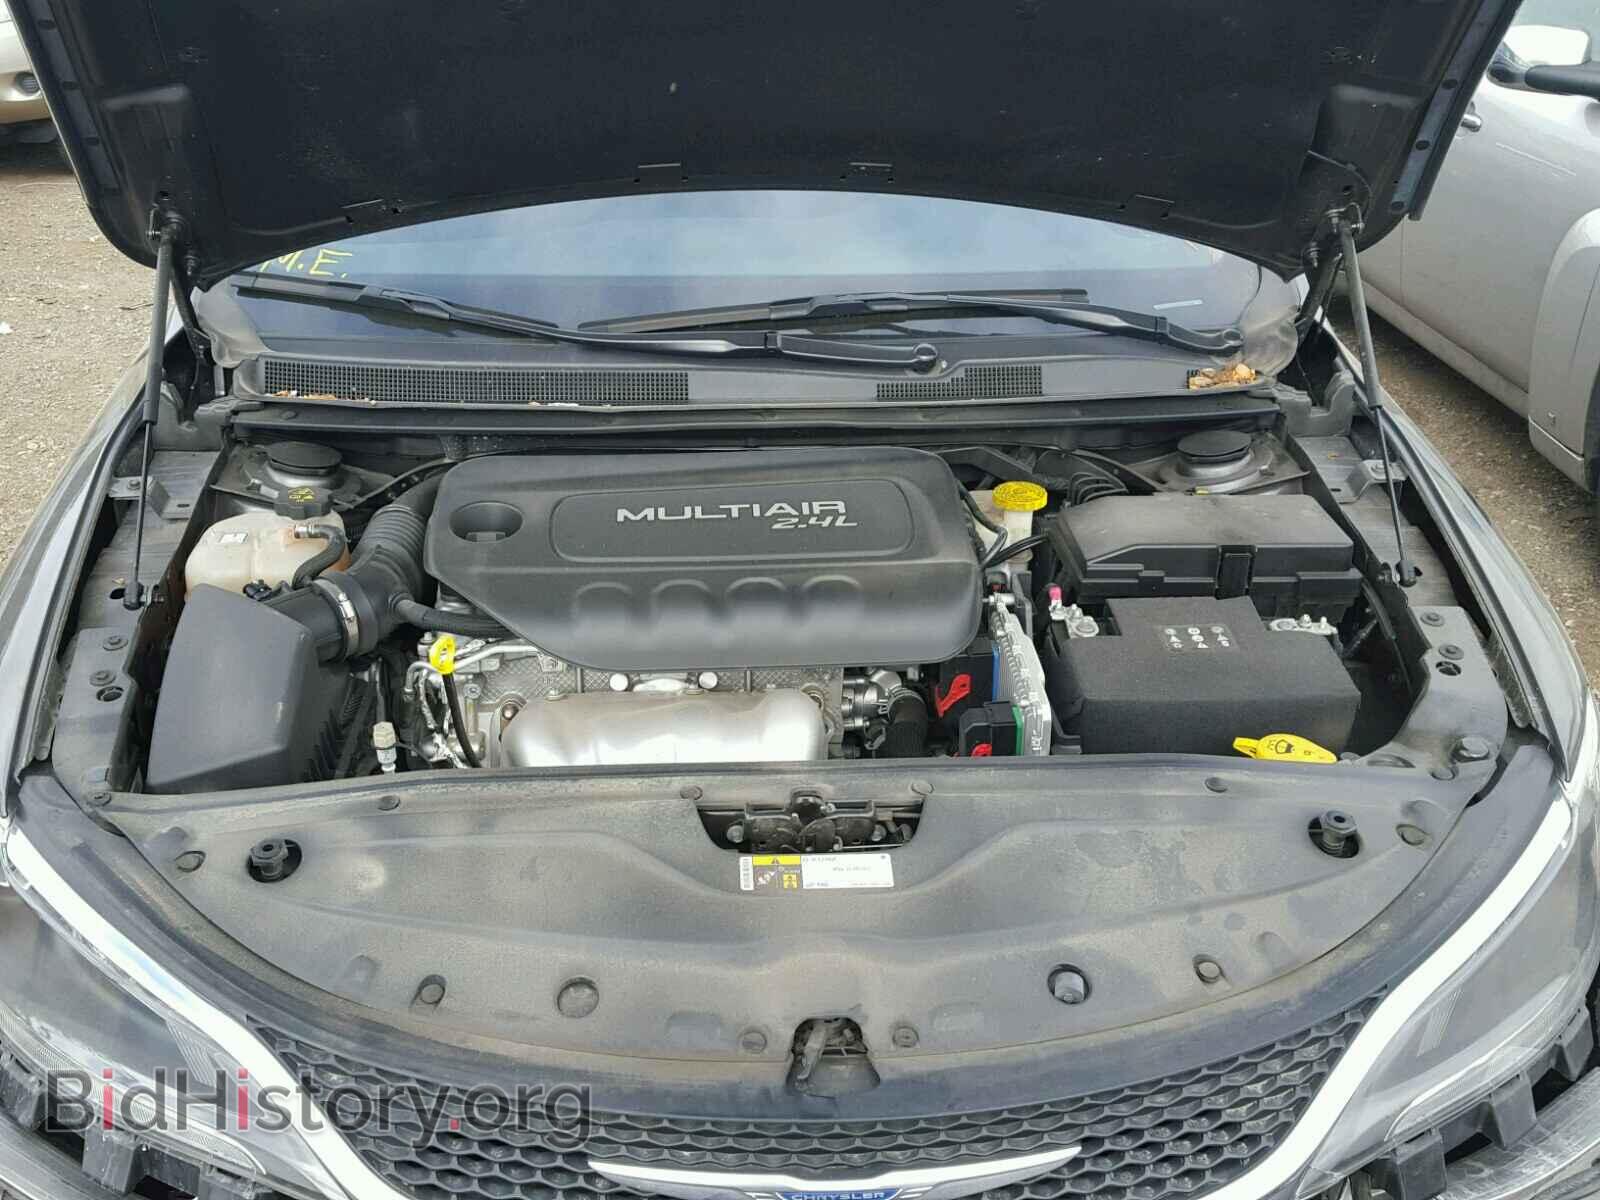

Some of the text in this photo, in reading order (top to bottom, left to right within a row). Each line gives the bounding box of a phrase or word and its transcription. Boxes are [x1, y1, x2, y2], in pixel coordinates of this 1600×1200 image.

[616, 500, 847, 523] MULTIAIR
[771, 515, 858, 530] 2.4L
[791, 1191, 885, 1200] CHRYSLER
